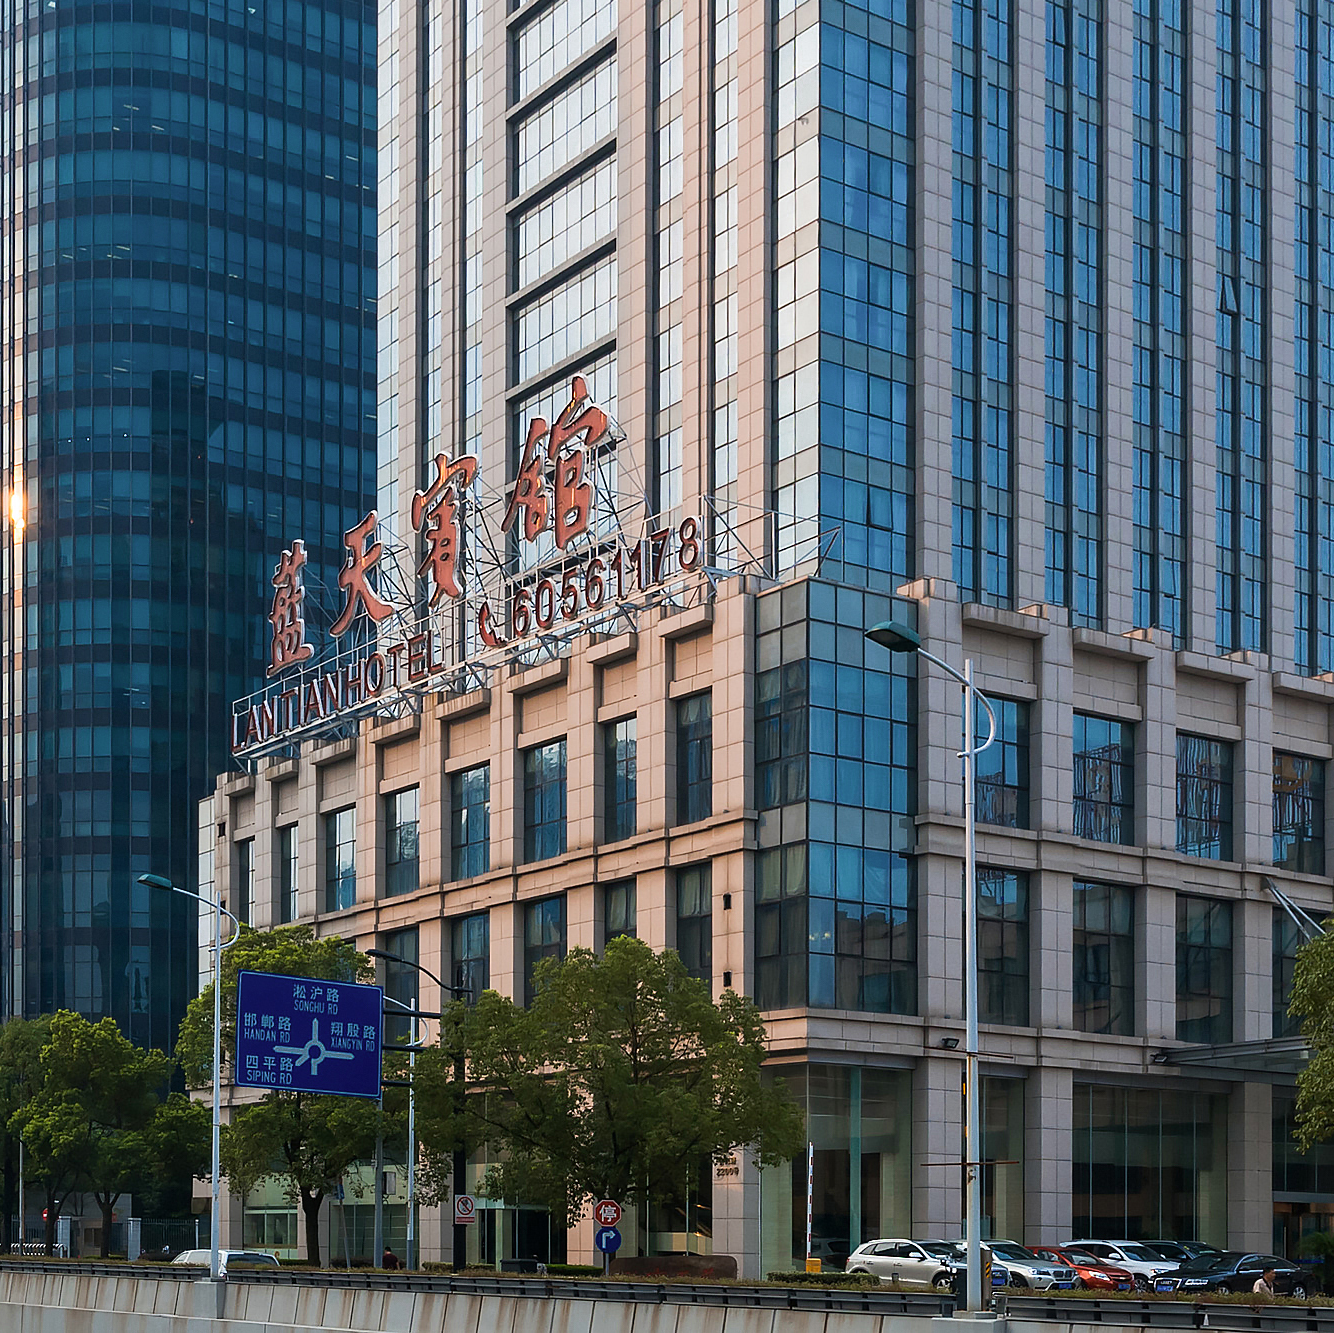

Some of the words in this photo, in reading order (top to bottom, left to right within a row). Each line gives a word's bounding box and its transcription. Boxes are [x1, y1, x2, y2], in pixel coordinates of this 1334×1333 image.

[512, 515, 703, 639] 60561178
[293, 984, 339, 1003] 淞沪路
[294, 999, 325, 1014] SONGHU
[327, 1003, 338, 1015] RD
[244, 1012, 292, 1031] 邯郸路
[331, 1021, 376, 1040] 翔殷路
[244, 1028, 277, 1042] HANDAN
[280, 1032, 291, 1043] RD
[331, 1036, 363, 1051] XIANGYIN
[365, 1040, 375, 1052] RD
[246, 1055, 294, 1072] 四平路
[246, 1069, 277, 1083] SIPING
[280, 1072, 293, 1085] RD
[599, 1204, 617, 1223] 停
